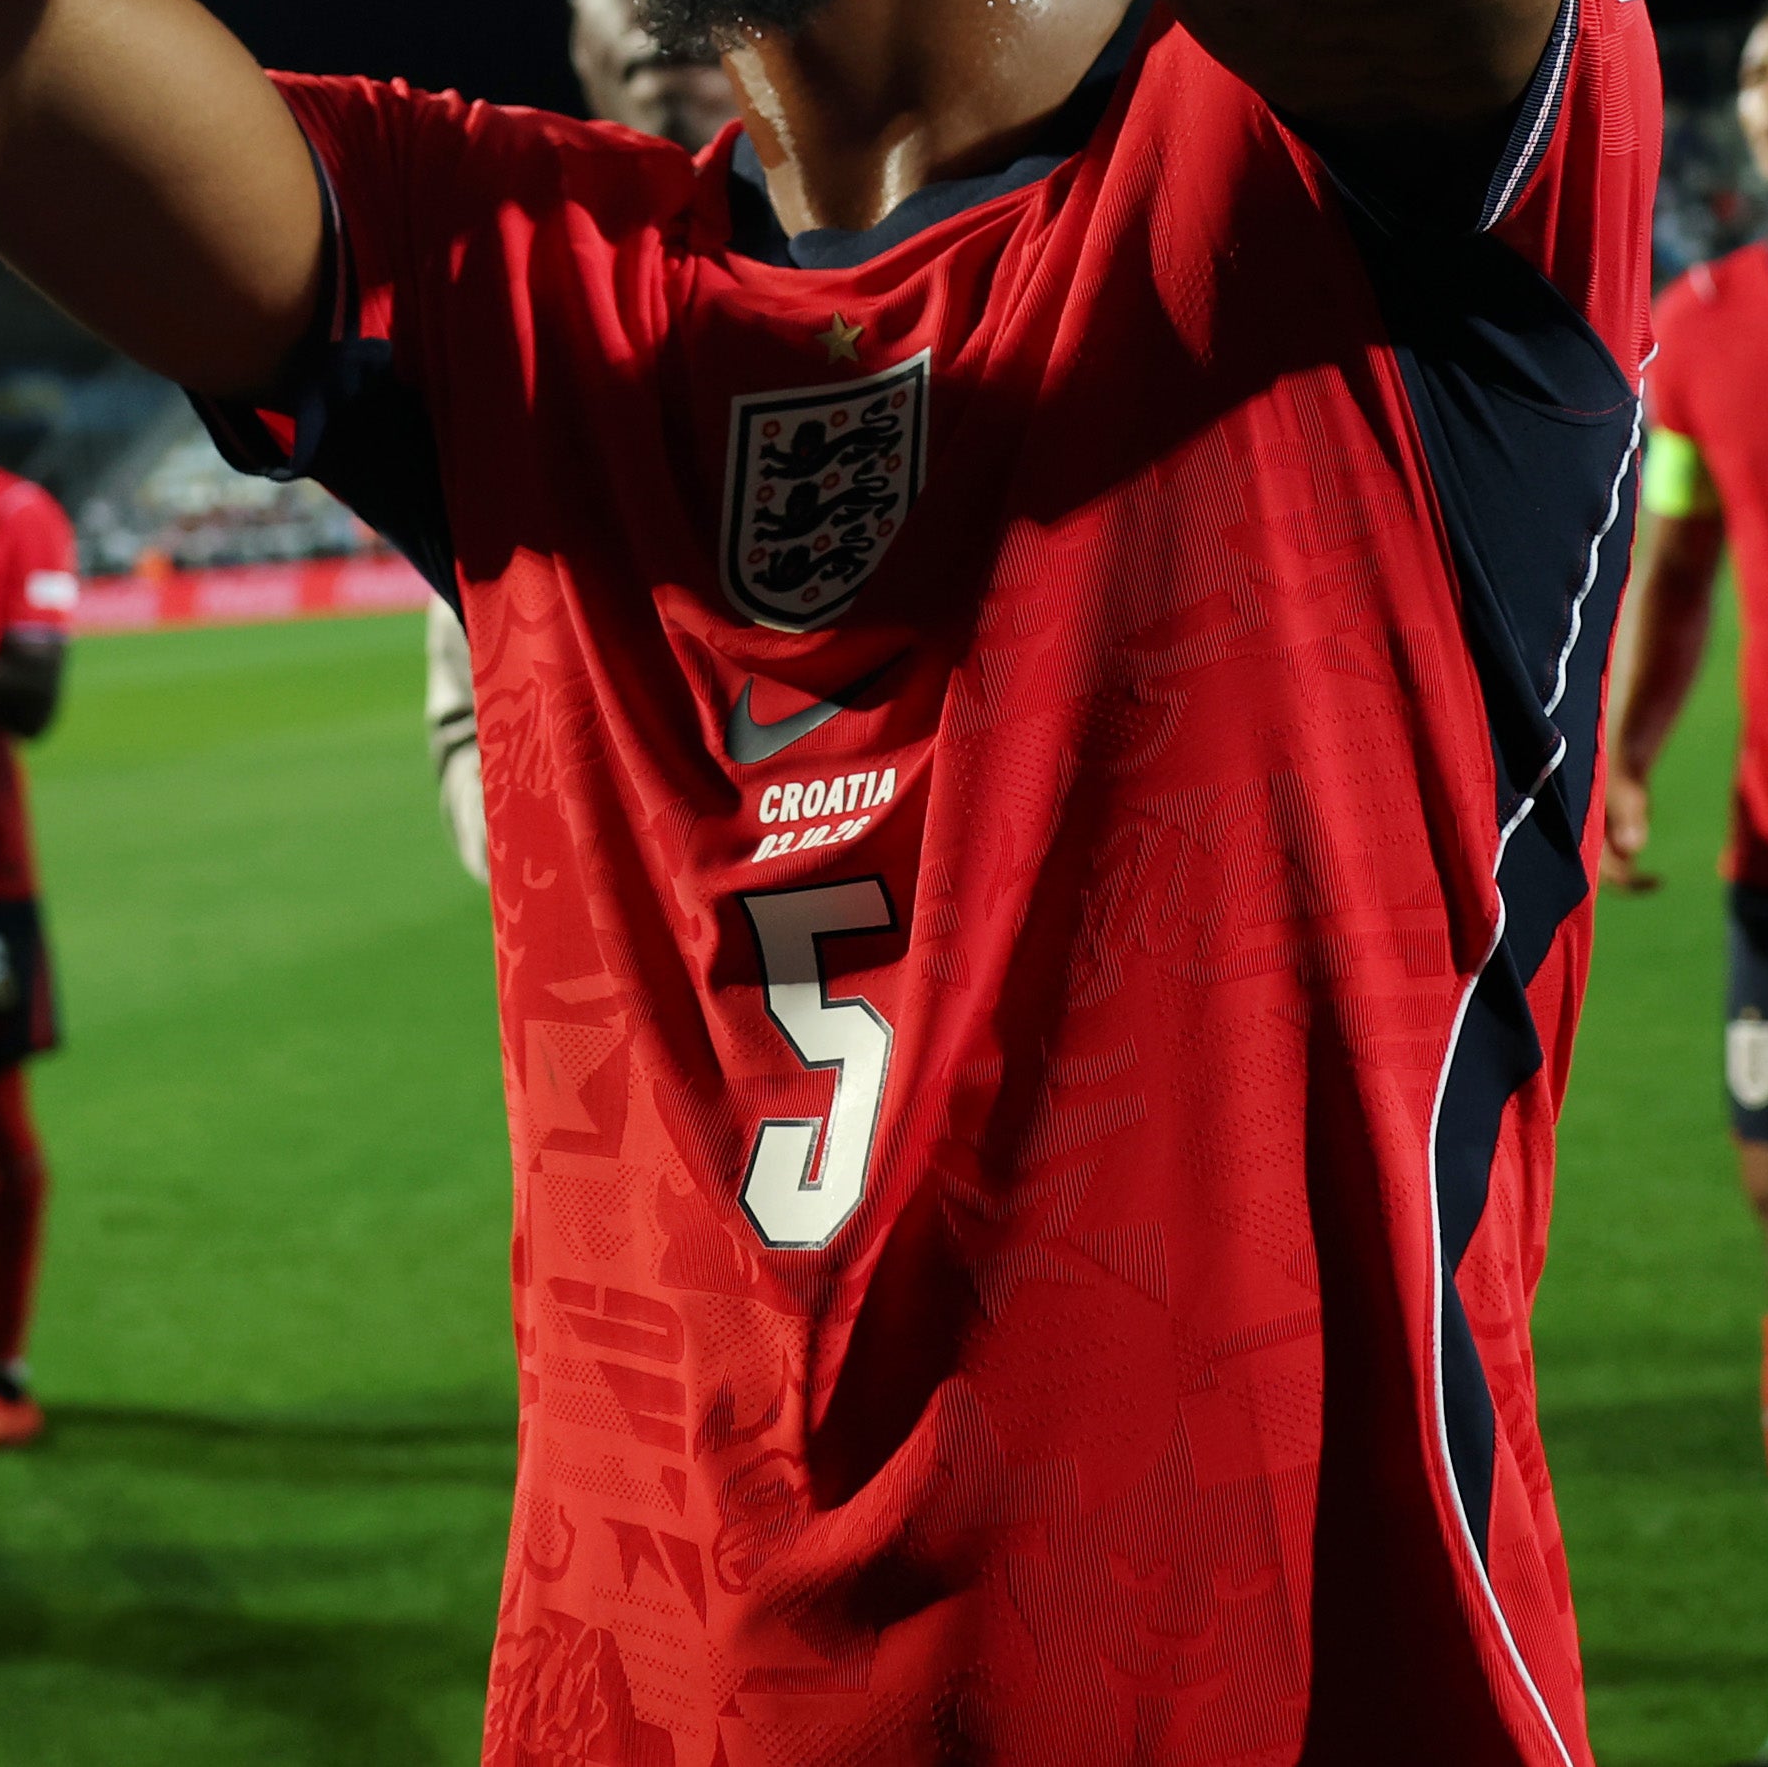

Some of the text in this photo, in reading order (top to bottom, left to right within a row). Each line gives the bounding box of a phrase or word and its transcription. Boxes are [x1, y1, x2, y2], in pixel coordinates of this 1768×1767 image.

[759, 768, 896, 824] CROATIA
[751, 815, 871, 863] 03.10.26
[736, 873, 897, 1250] 5
